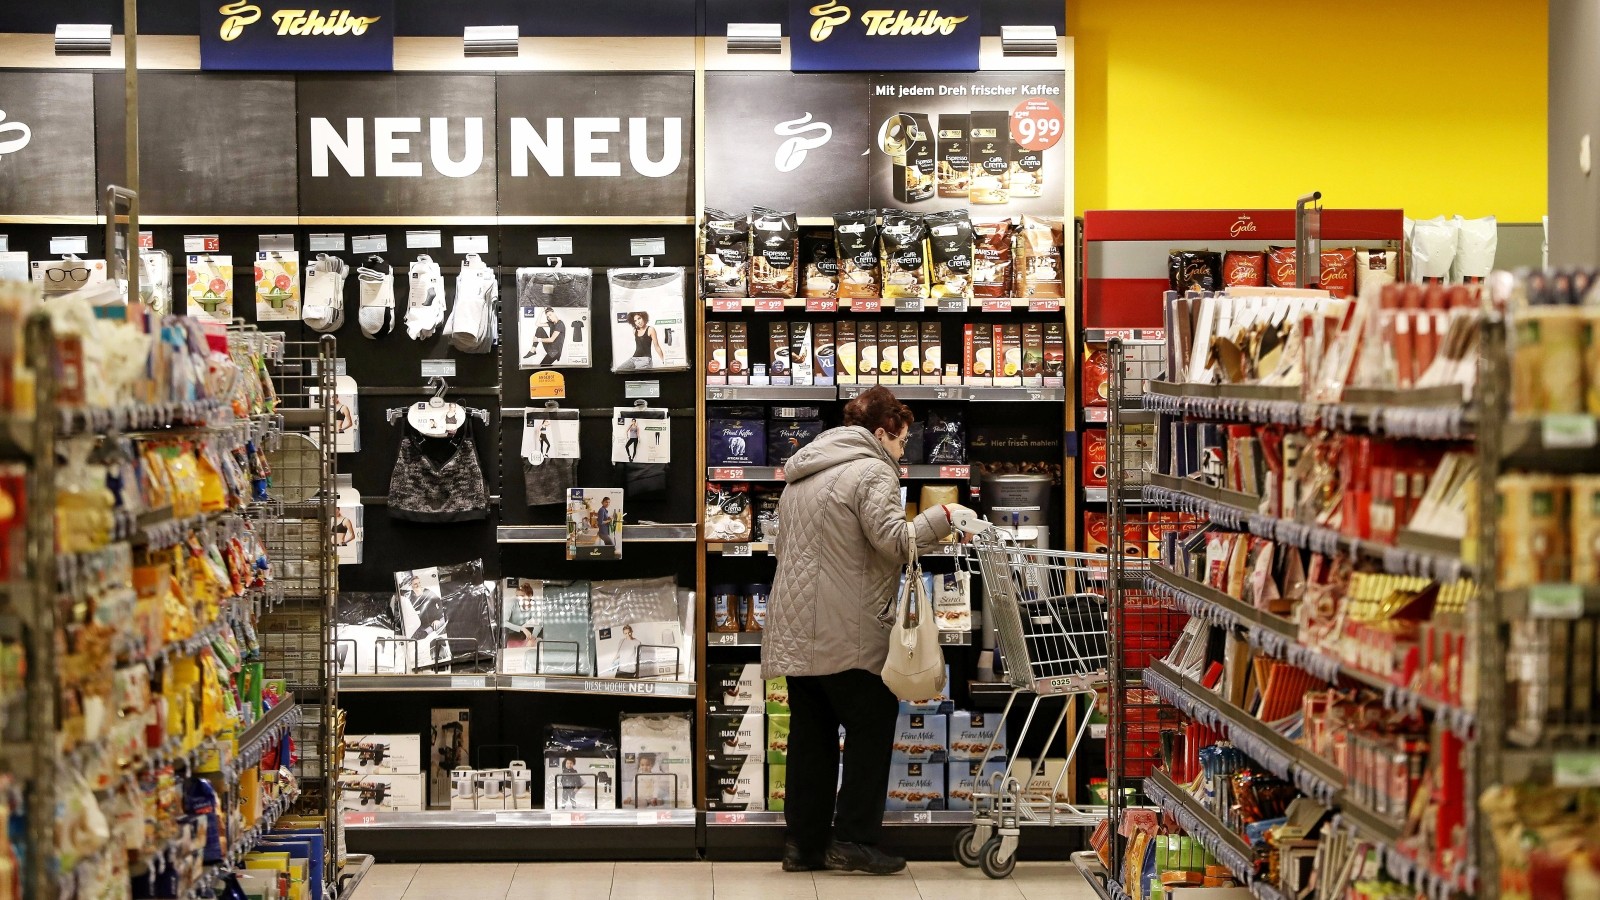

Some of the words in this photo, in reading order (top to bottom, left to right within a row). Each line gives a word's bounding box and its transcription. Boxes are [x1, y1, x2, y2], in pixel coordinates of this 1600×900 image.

[272, 9, 381, 36] Tchibo
[861, 9, 969, 36] Tchibo
[875, 85, 895, 96] Mit
[898, 85, 934, 98] jedem
[938, 85, 966, 96] Dreh
[970, 84, 1017, 96] frischer
[1021, 84, 1060, 96] Kaffee
[310, 117, 484, 177] NEU
[510, 117, 682, 177] NEU
[1230, 220, 1257, 237] Gala
[762, 249, 787, 257] Espresso
[947, 259, 971, 267] Crema
[1184, 263, 1211, 281] Gala
[1230, 266, 1258, 284] Gala
[1277, 264, 1296, 282] Ga
[1320, 267, 1348, 285] Gala
[820, 359, 834, 368] XL
[722, 428, 738, 437] Privat
[739, 428, 754, 438] Kaffee
[1008, 439, 1028, 447] frisch
[584, 681, 601, 691] DIESE
[604, 682, 626, 692] WOCHE
[628, 682, 654, 693] NEU
[722, 679, 737, 687] BLACK
[771, 682, 784, 691] Der
[774, 731, 787, 739] Der
[900, 731, 917, 741] Feine
[917, 731, 935, 740] Milde
[961, 730, 977, 740] Feine
[977, 730, 994, 739] Mild
[774, 780, 785, 789] De
[898, 779, 915, 788] Feine
[915, 779, 933, 788] Milde
